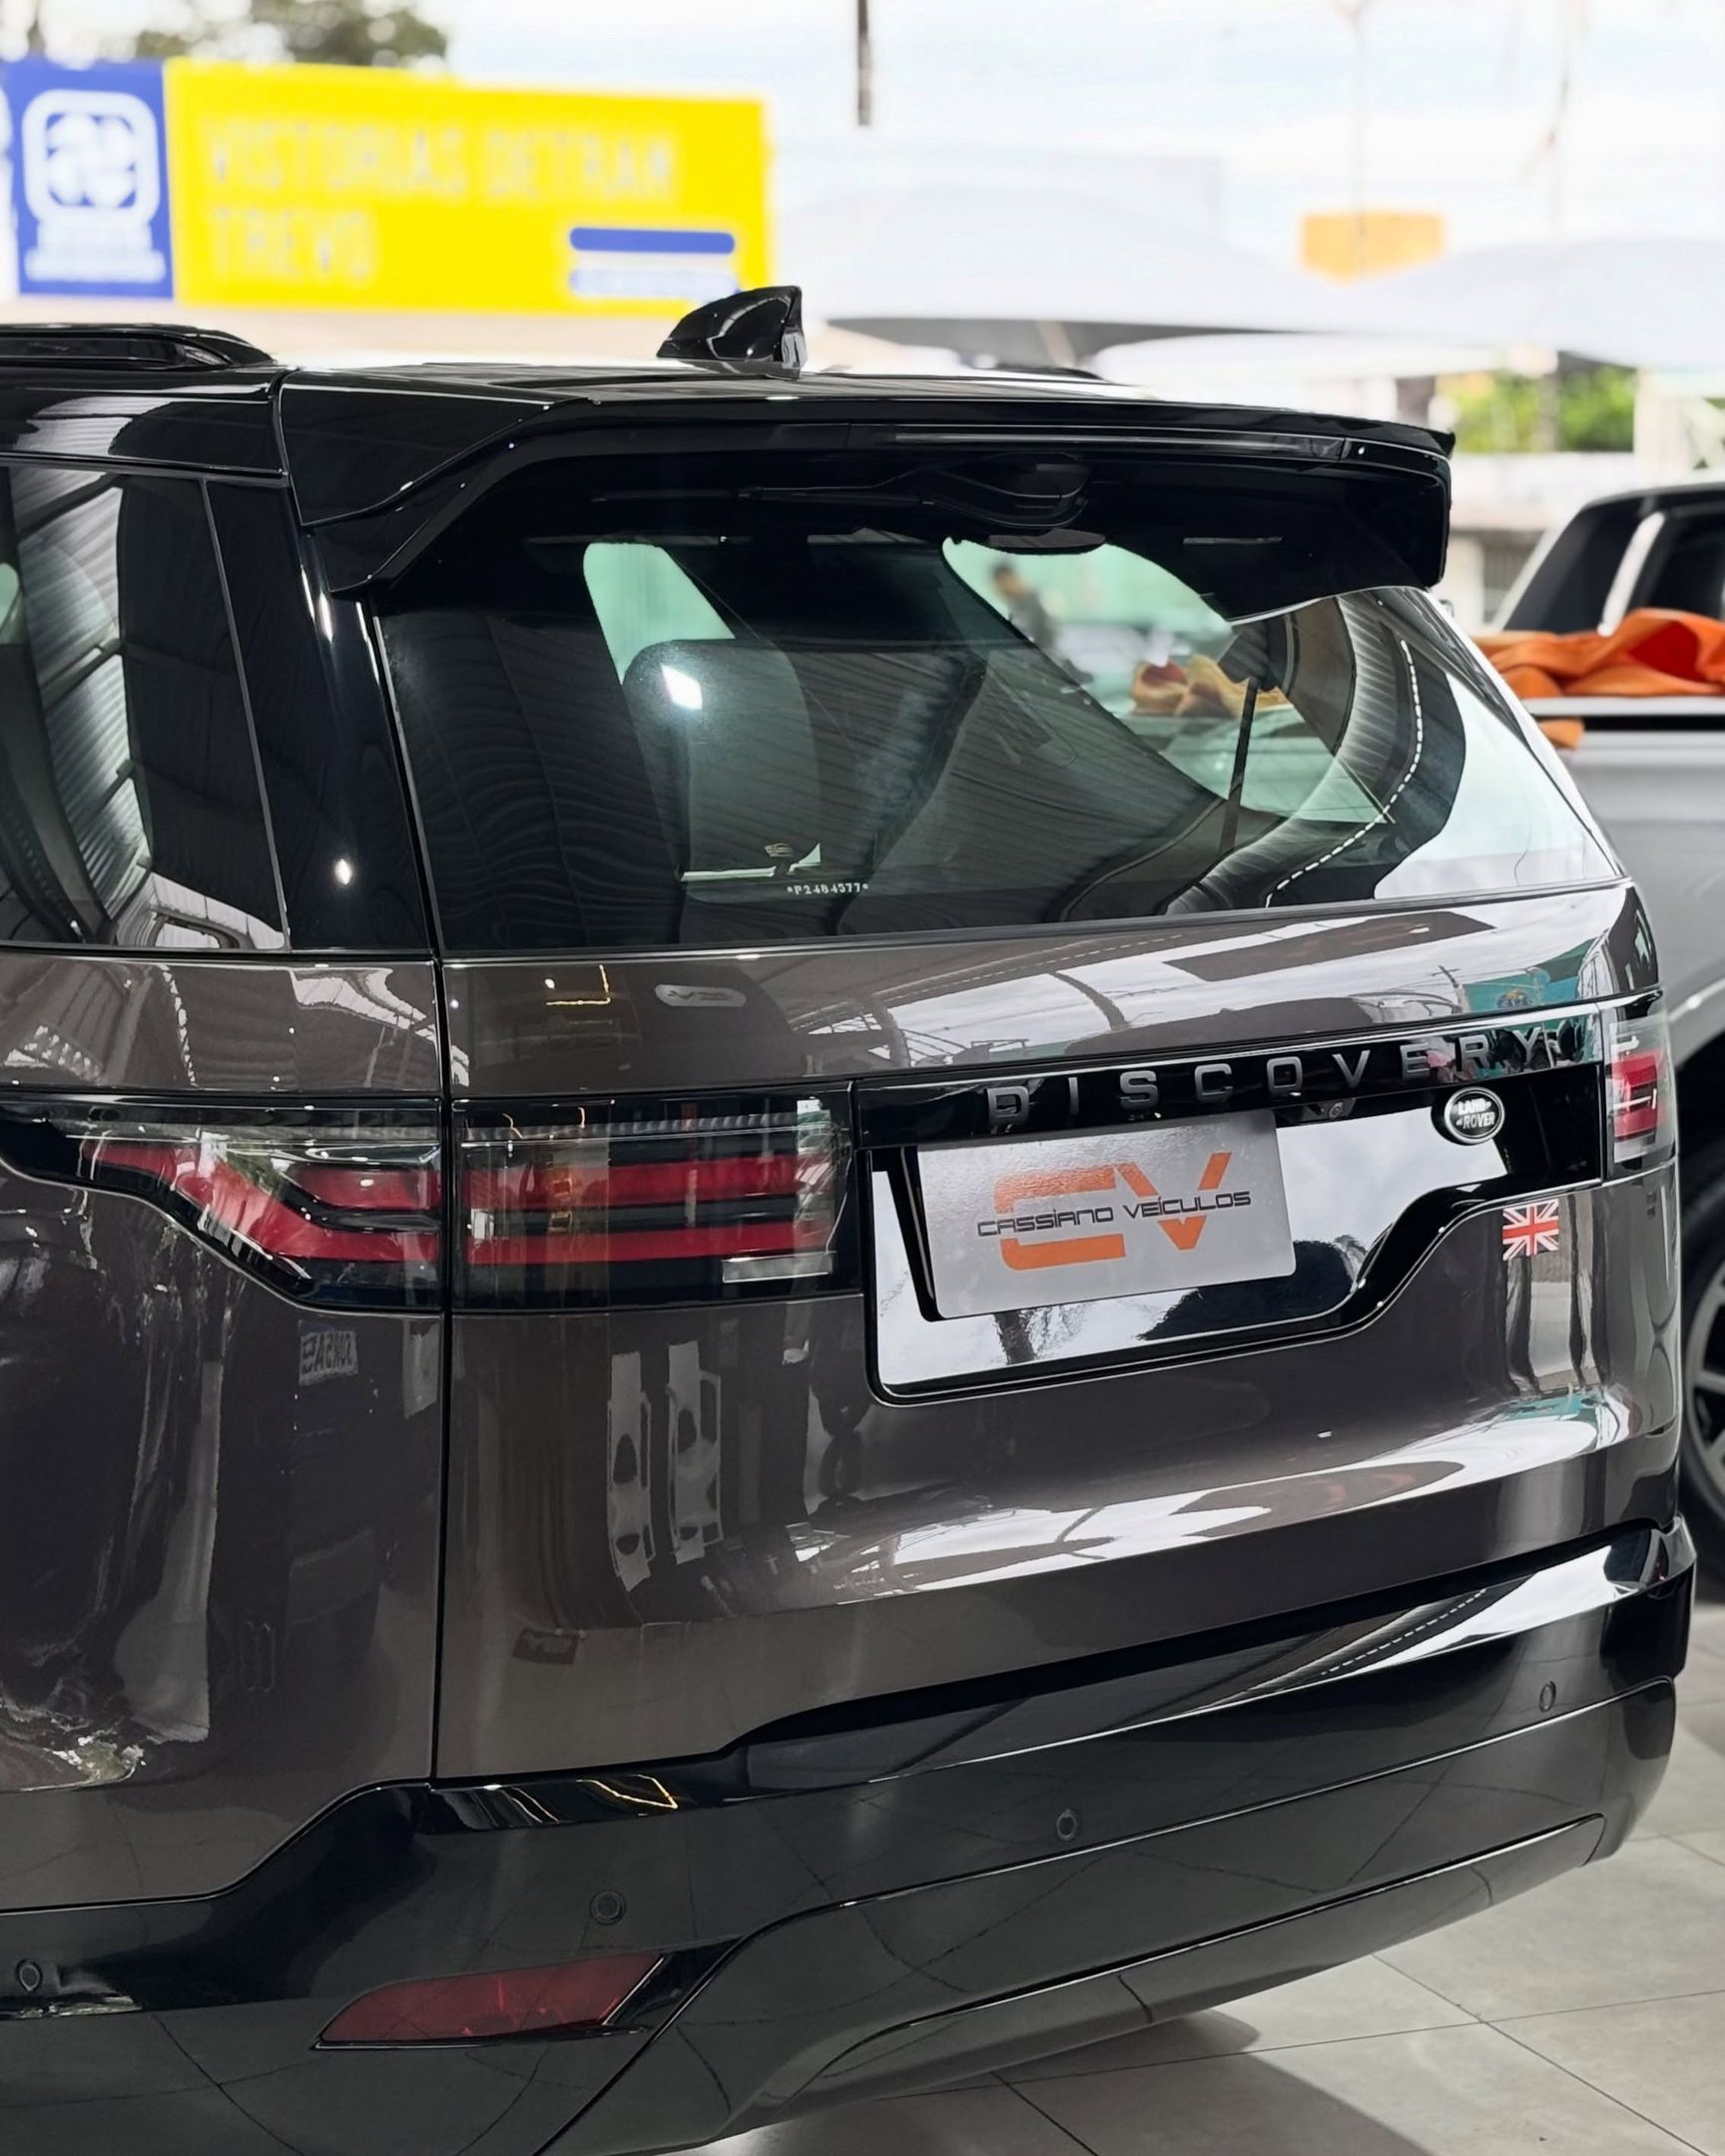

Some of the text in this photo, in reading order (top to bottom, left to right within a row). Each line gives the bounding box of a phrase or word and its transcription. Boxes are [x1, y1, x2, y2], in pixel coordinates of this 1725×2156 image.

[987, 1026, 1541, 1123] DISCOVERY
[1457, 1098, 1486, 1116] LAND
[1462, 1112, 1495, 1129] ROVER
[1123, 1191, 1252, 1219] VEÍCULOS
